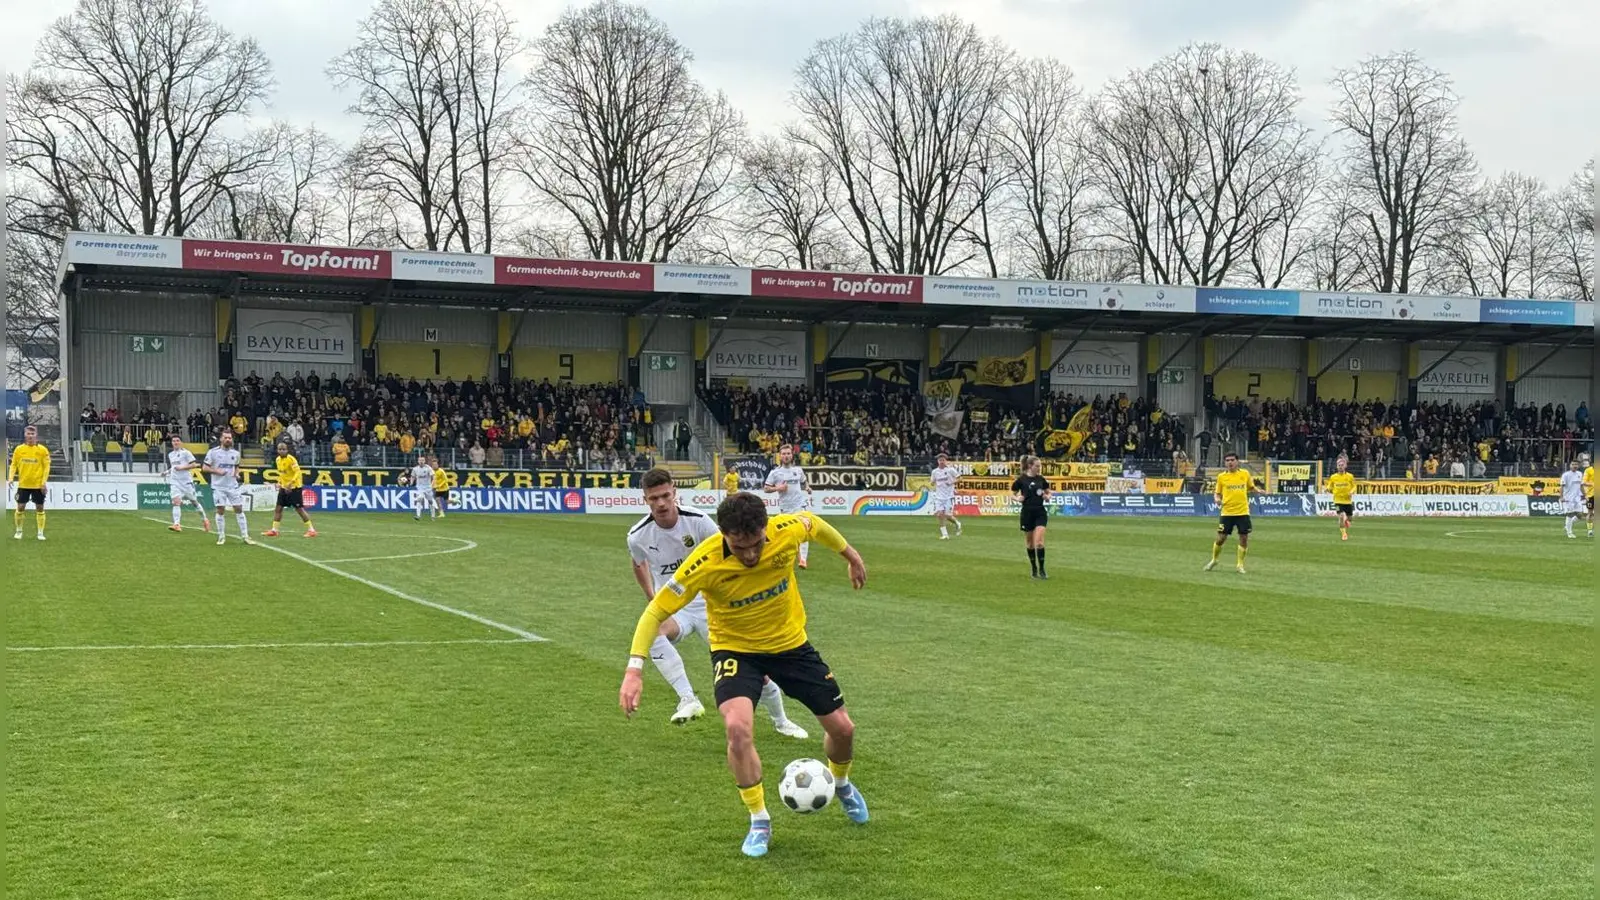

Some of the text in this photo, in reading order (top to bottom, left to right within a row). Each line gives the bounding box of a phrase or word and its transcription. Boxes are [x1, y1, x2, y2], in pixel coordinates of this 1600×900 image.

[75, 240, 159, 251] Formentechnik
[116, 250, 167, 260] Bayreuth
[193, 248, 380, 271] Wir bringen's in Topform!
[401, 258, 476, 268] Formentechnik
[437, 267, 484, 276] Bayreuth
[506, 264, 641, 280] formentechnik-bayreuth.de
[663, 271, 732, 280] Formentechnik
[761, 277, 776, 286] Wir
[777, 278, 816, 289] bringen's
[832, 276, 913, 296] Topform!
[933, 283, 995, 292] Formentechnik
[1017, 285, 1088, 299] motion
[1318, 296, 1383, 309] motion
[425, 329, 437, 341] M
[247, 335, 344, 353] BAYREUTH
[867, 344, 877, 356] N
[432, 348, 440, 375] 1
[559, 353, 574, 380] 9
[715, 352, 798, 369] BAYREUTH
[1057, 363, 1131, 378] BAYREUTH
[1247, 373, 1261, 398] 2
[1422, 372, 1489, 387] BAYREUTH
[446, 472, 631, 488] BAYREUTH
[1061, 482, 1106, 491] BAYREUTH
[63, 489, 129, 503] brands
[447, 490, 562, 511] BRUNNEN
[867, 498, 912, 507] SW color
[981, 495, 1000, 505] IST
[1259, 496, 1289, 506] BALL!
[1317, 500, 1404, 511] WEICH.COM
[1425, 501, 1508, 512] WEDLICH.COM
[729, 577, 789, 609] maxit
[714, 658, 738, 683] 29
